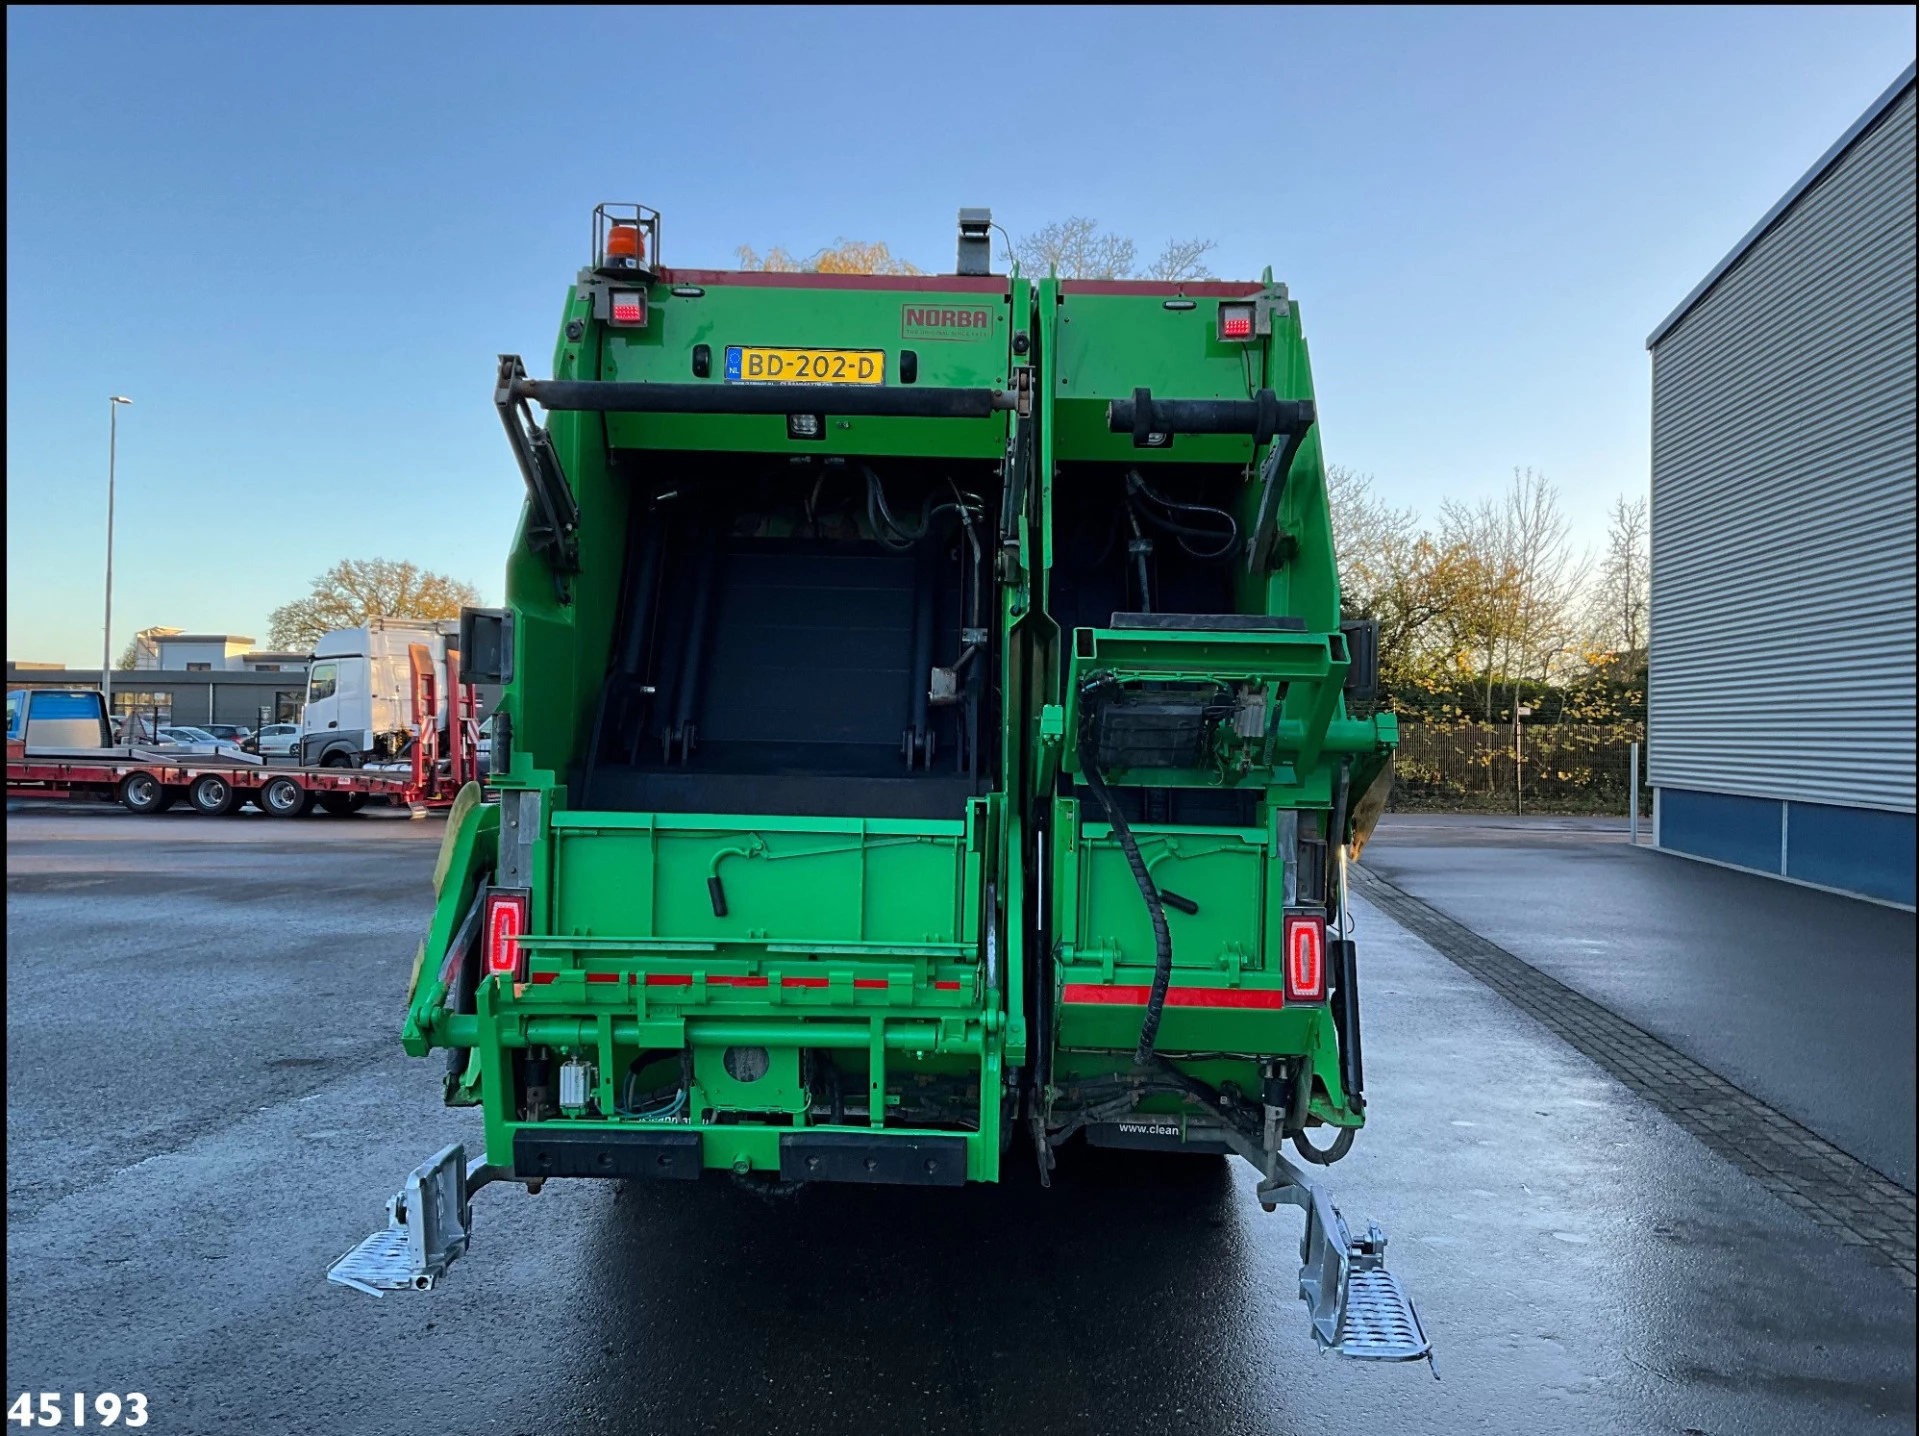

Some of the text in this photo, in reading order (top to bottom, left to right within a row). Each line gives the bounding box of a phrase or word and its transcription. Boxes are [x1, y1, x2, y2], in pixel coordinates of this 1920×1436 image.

[906, 308, 987, 328] NORBA
[748, 353, 874, 379] BD-202-D
[1119, 1124, 1179, 1135] www.clean
